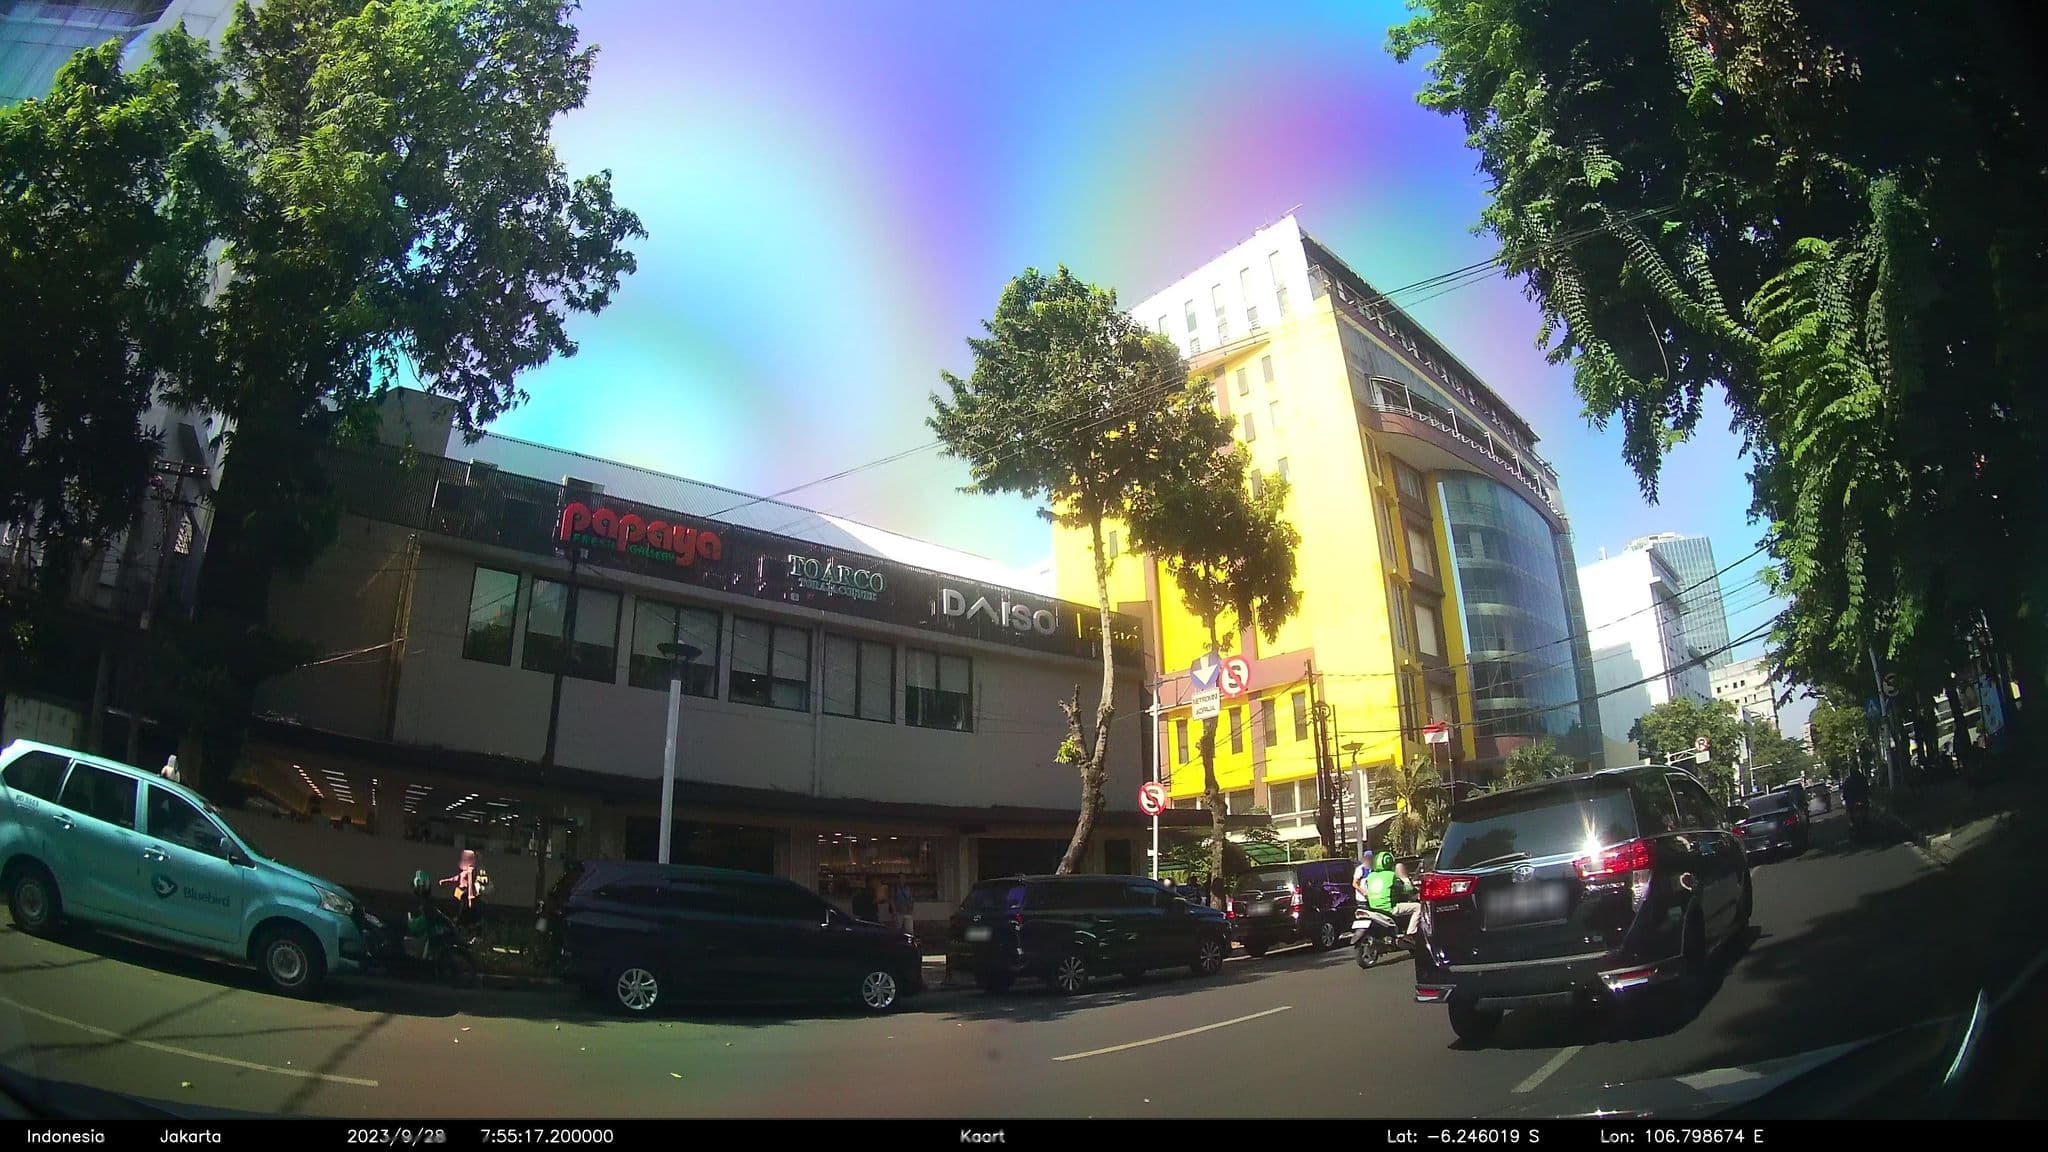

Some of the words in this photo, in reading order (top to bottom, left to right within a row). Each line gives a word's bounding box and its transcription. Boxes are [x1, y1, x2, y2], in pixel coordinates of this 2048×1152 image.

[560, 502, 722, 567] papaya
[788, 554, 886, 592] TOARCO
[943, 589, 1056, 635] DAISO
[183, 887, 230, 907] Bluebird
